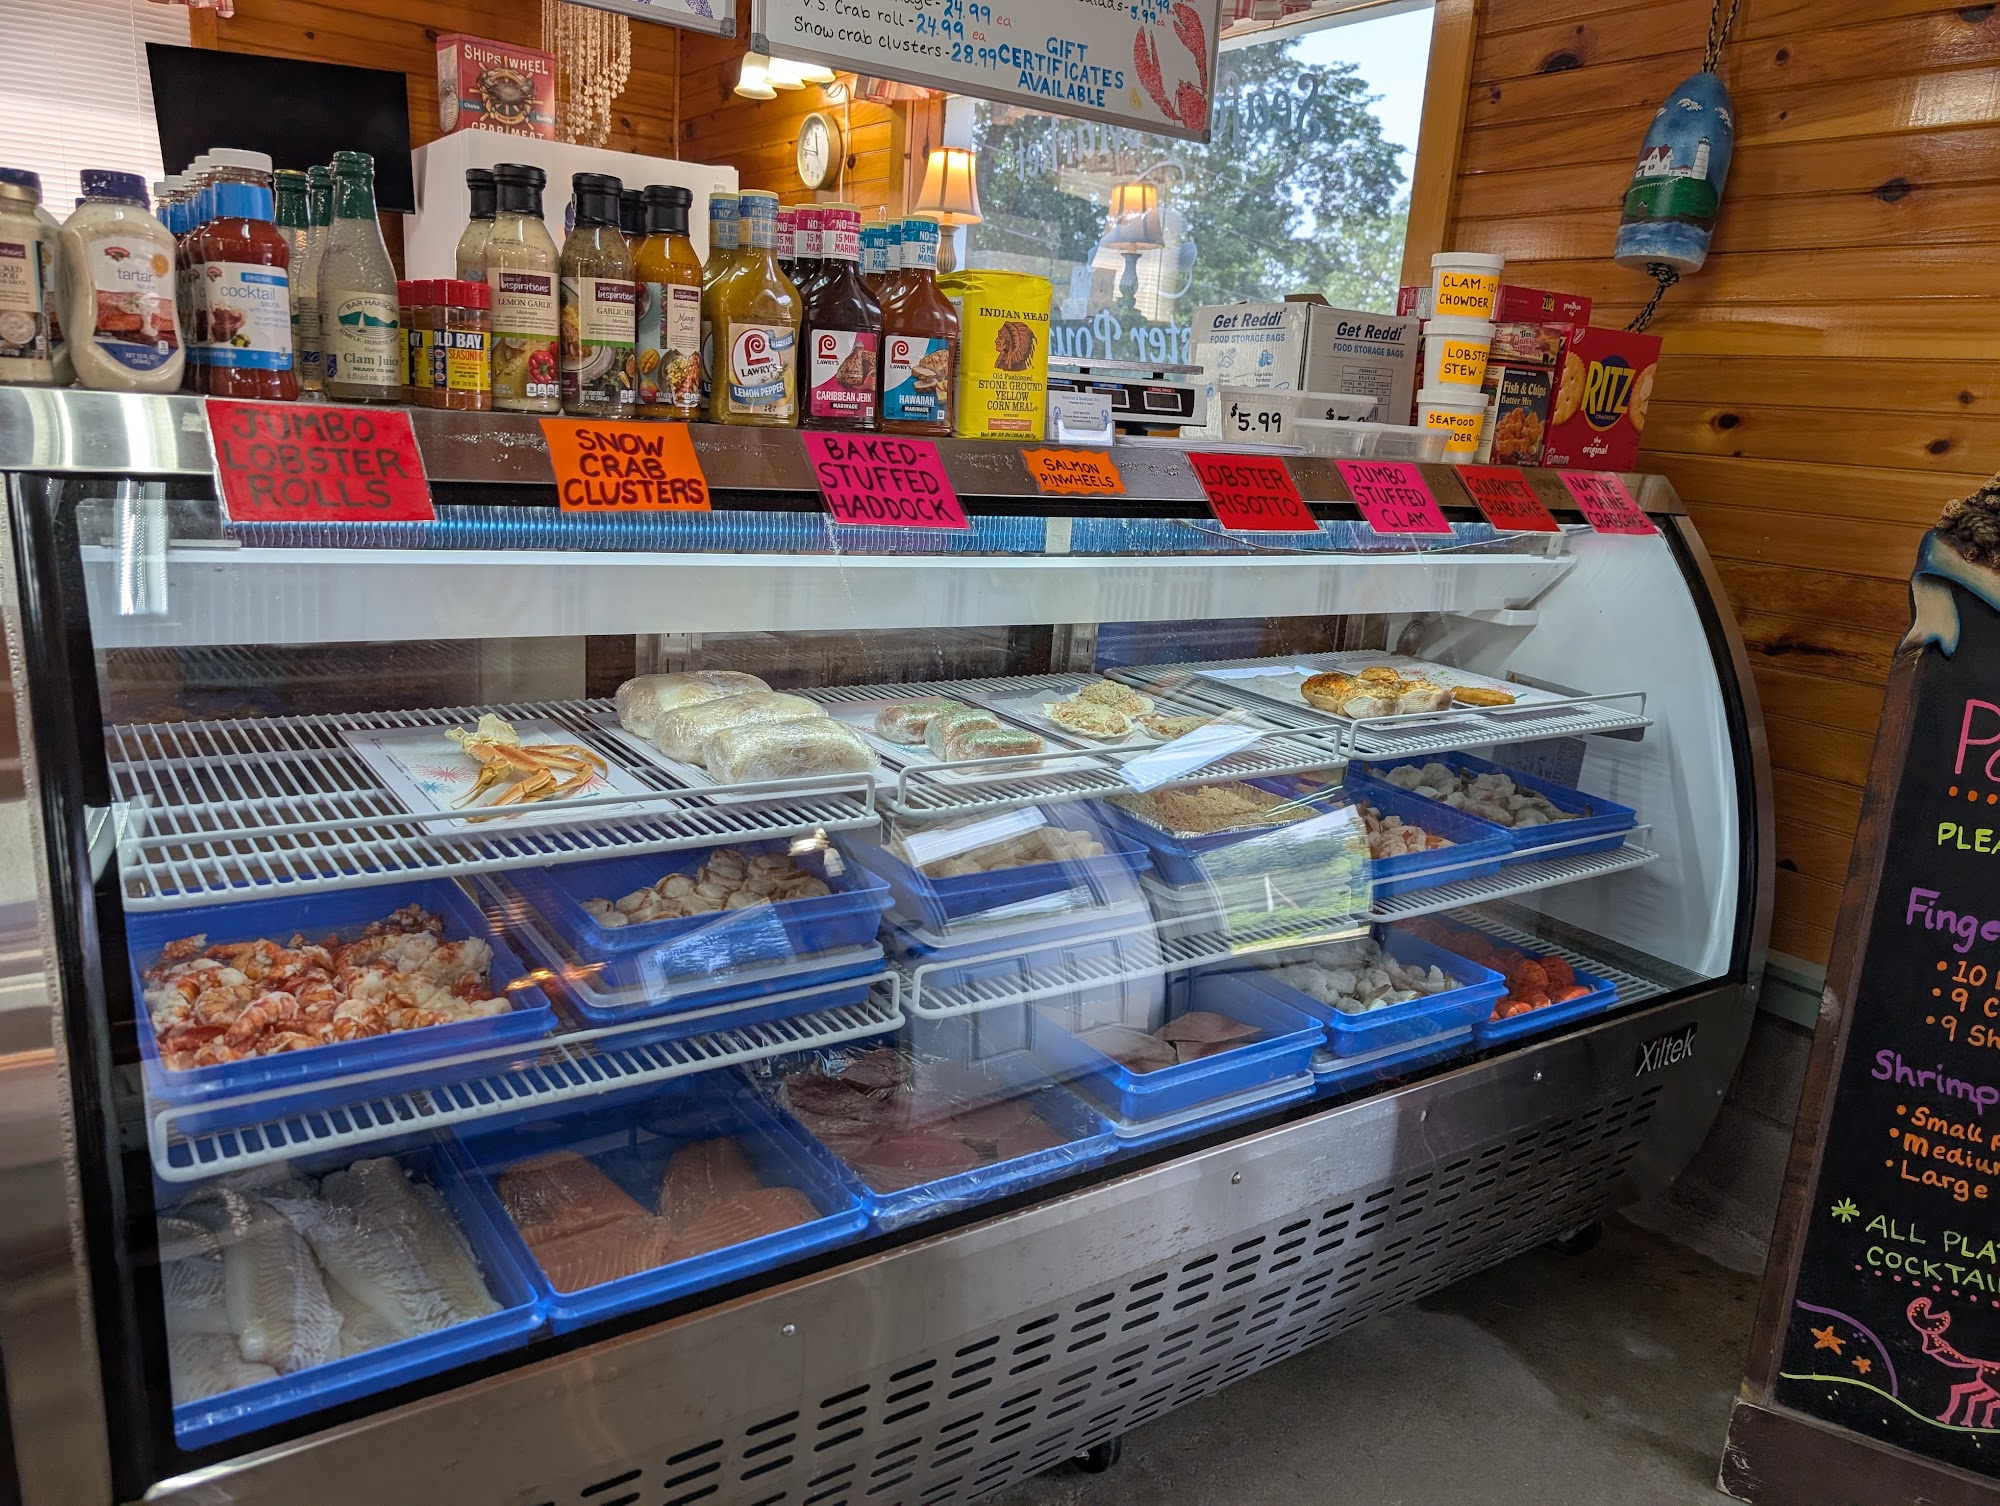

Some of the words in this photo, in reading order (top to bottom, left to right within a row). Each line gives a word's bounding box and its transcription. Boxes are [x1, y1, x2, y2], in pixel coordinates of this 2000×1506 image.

[834, 0, 871, 20] Crab
[915, 12, 965, 41] 24.99
[971, 30, 987, 43] ea
[1129, 5, 1157, 25] 5.99
[793, 14, 835, 40] Snow
[838, 28, 873, 46] crab
[950, 41, 997, 71] 28.99
[1046, 36, 1089, 63] GIFT
[463, 43, 502, 65] SHIPS
[508, 57, 549, 75] WHEEL
[999, 43, 1125, 90] CERTIFICATES
[1017, 70, 1106, 108] AVAILABLE
[464, 102, 480, 110] Choice
[835, 219, 847, 230] NO
[835, 233, 842, 242] 15
[843, 234, 856, 244] MIN
[873, 238, 884, 247] NO
[920, 231, 929, 241] NO
[919, 244, 926, 253] 15
[117, 268, 154, 282] tartar
[220, 285, 276, 301] cocktail
[501, 281, 550, 294] Inspirations
[345, 301, 363, 311] BAR
[497, 296, 526, 307] LEMON
[527, 299, 553, 310] GARLIC
[1439, 292, 1490, 309] CHOWDER
[596, 306, 624, 317] GARLIC
[673, 312, 697, 325] Mango
[979, 307, 1021, 320] INDIAN
[1023, 311, 1049, 322] HEAD
[1212, 313, 1239, 330] Get
[1240, 311, 1283, 329] Reddi
[679, 322, 695, 332] Sauce
[1336, 321, 1362, 338] Get
[1364, 324, 1404, 342] Reddi
[433, 331, 454, 348] OLD
[455, 332, 482, 350] BAY
[1209, 334, 1231, 344] FOOD
[1230, 333, 1265, 343] STORAGE
[1265, 332, 1286, 343] BAGS
[343, 352, 375, 365] Clam
[448, 349, 484, 362] SEASONING
[1332, 342, 1353, 353] FOOD
[1353, 345, 1386, 357] STORAGE
[1385, 347, 1404, 359] BAGS
[740, 363, 778, 378] LAWRY'S
[992, 372, 1003, 380] Old
[1003, 373, 1034, 381] Fashioned
[733, 385, 760, 399] LEMON
[760, 380, 785, 397] PEPPER
[978, 380, 1008, 390] STONE
[1009, 381, 1043, 392] GROUND
[995, 390, 1030, 401] YELLOW
[1502, 380, 1520, 395] Fish
[1520, 382, 1527, 396] &
[1527, 383, 1547, 398] Chips
[1580, 360, 1637, 415] RITZ
[815, 390, 856, 402] CARIBBEAN
[856, 392, 872, 403] JERK
[832, 402, 859, 410] MARINADE
[898, 394, 935, 406] HAWAIIAN
[986, 400, 1011, 411] CORN
[1011, 402, 1035, 412] MEAL
[1500, 394, 1522, 406] Batter
[1521, 395, 1533, 407] Mix
[231, 407, 375, 443] JUMBO
[1229, 401, 1283, 434] $5.99
[1428, 413, 1475, 427] SEAFOOD
[574, 428, 664, 458] SNOW
[1593, 436, 1601, 444] the
[221, 441, 408, 479] LOBSTER
[822, 436, 928, 466] BAKED-
[1582, 444, 1609, 458] original
[579, 452, 667, 480] CRAB
[1042, 457, 1100, 474] SALMON
[1347, 464, 1407, 486] JUMBO
[818, 461, 940, 496] STUFFED
[1038, 472, 1115, 489] PINWHEELS
[1194, 462, 1291, 493] LOBSTER
[1465, 475, 1532, 499] GOURMET
[1567, 476, 1621, 496] NATIVE
[247, 473, 392, 509] ROLLS
[563, 477, 705, 507] CLUSTERS
[1352, 484, 1428, 508] STUFFED
[826, 492, 957, 522] HADDOCK
[1208, 491, 1300, 518] RISOTTO
[1477, 497, 1546, 518] CRABCAKE
[1583, 495, 1631, 512] MAINE
[1380, 508, 1435, 529] CLAM
[1587, 512, 1650, 530] CRABCAKE
[1951, 959, 1987, 987] 10
[1951, 986, 1969, 1013] 9
[1940, 1014, 1959, 1043] 9
[1635, 1027, 1696, 1077] Xiltek
[1871, 1049, 2000, 1116] Shrimp
[1910, 1105, 1984, 1144] Small
[1900, 1159, 1988, 1203] Large
[1864, 1213, 1927, 1246] ALL
